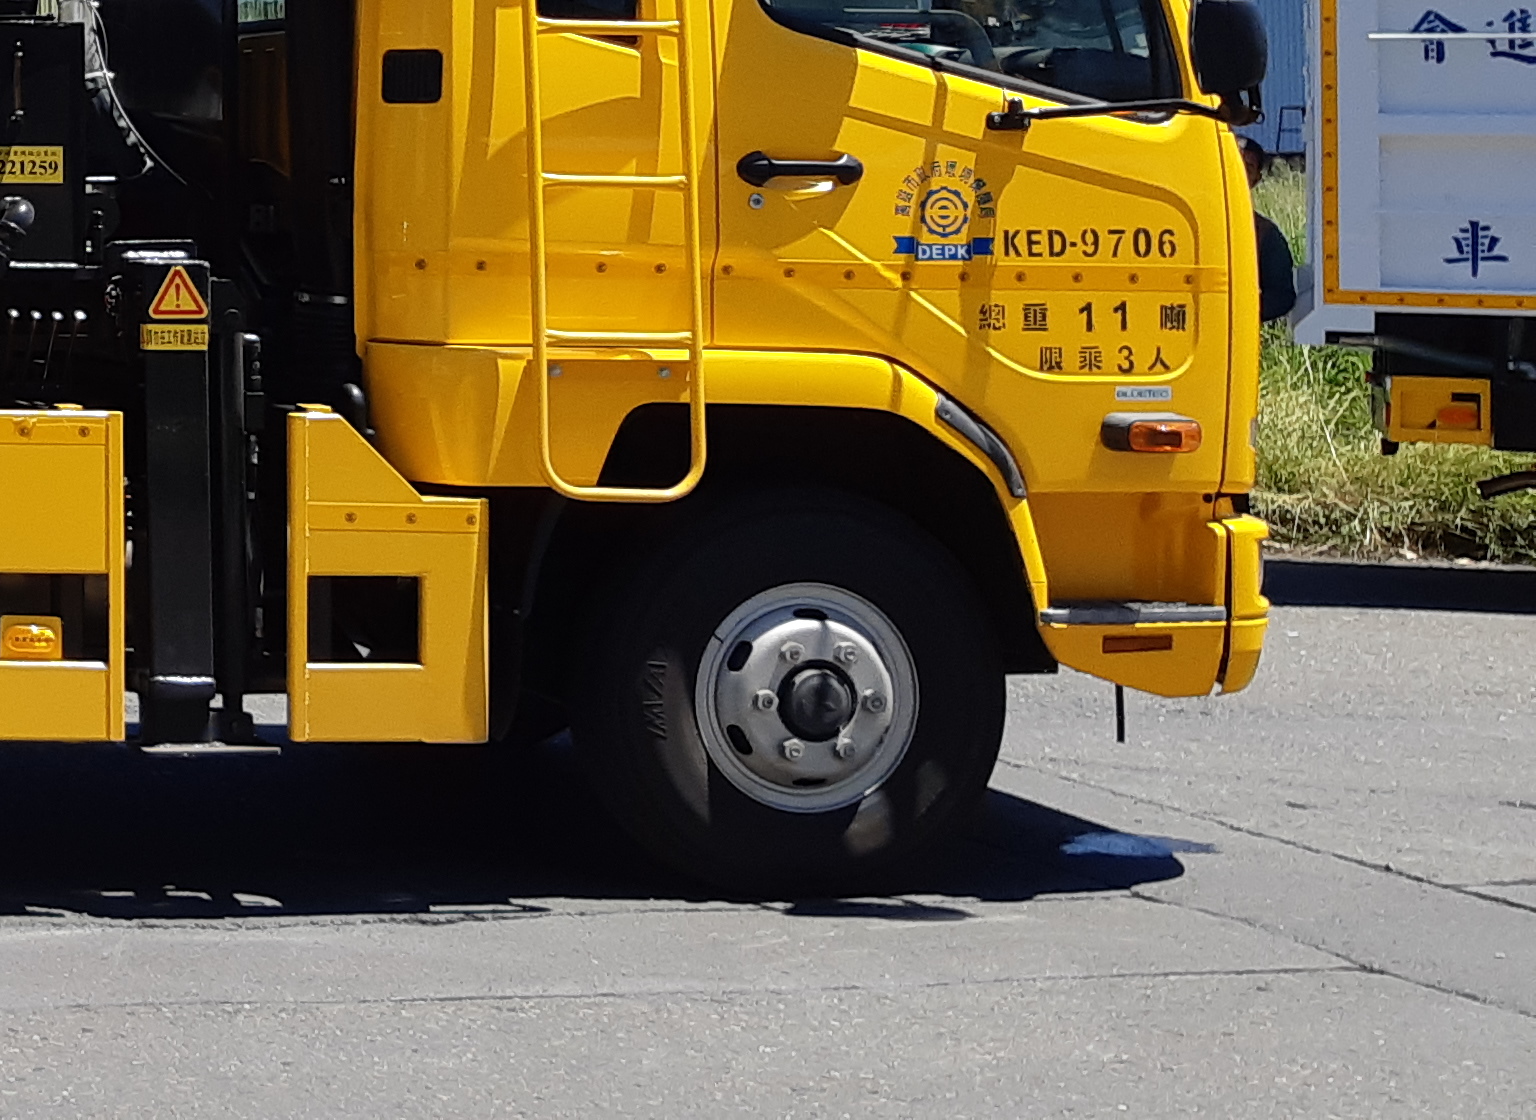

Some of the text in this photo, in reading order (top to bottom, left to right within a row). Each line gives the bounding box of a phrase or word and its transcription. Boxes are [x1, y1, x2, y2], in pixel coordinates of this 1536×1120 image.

[917, 245, 969, 259] DEPK
[1003, 228, 1177, 258] KED-9706
[1442, 219, 1510, 279] 車
